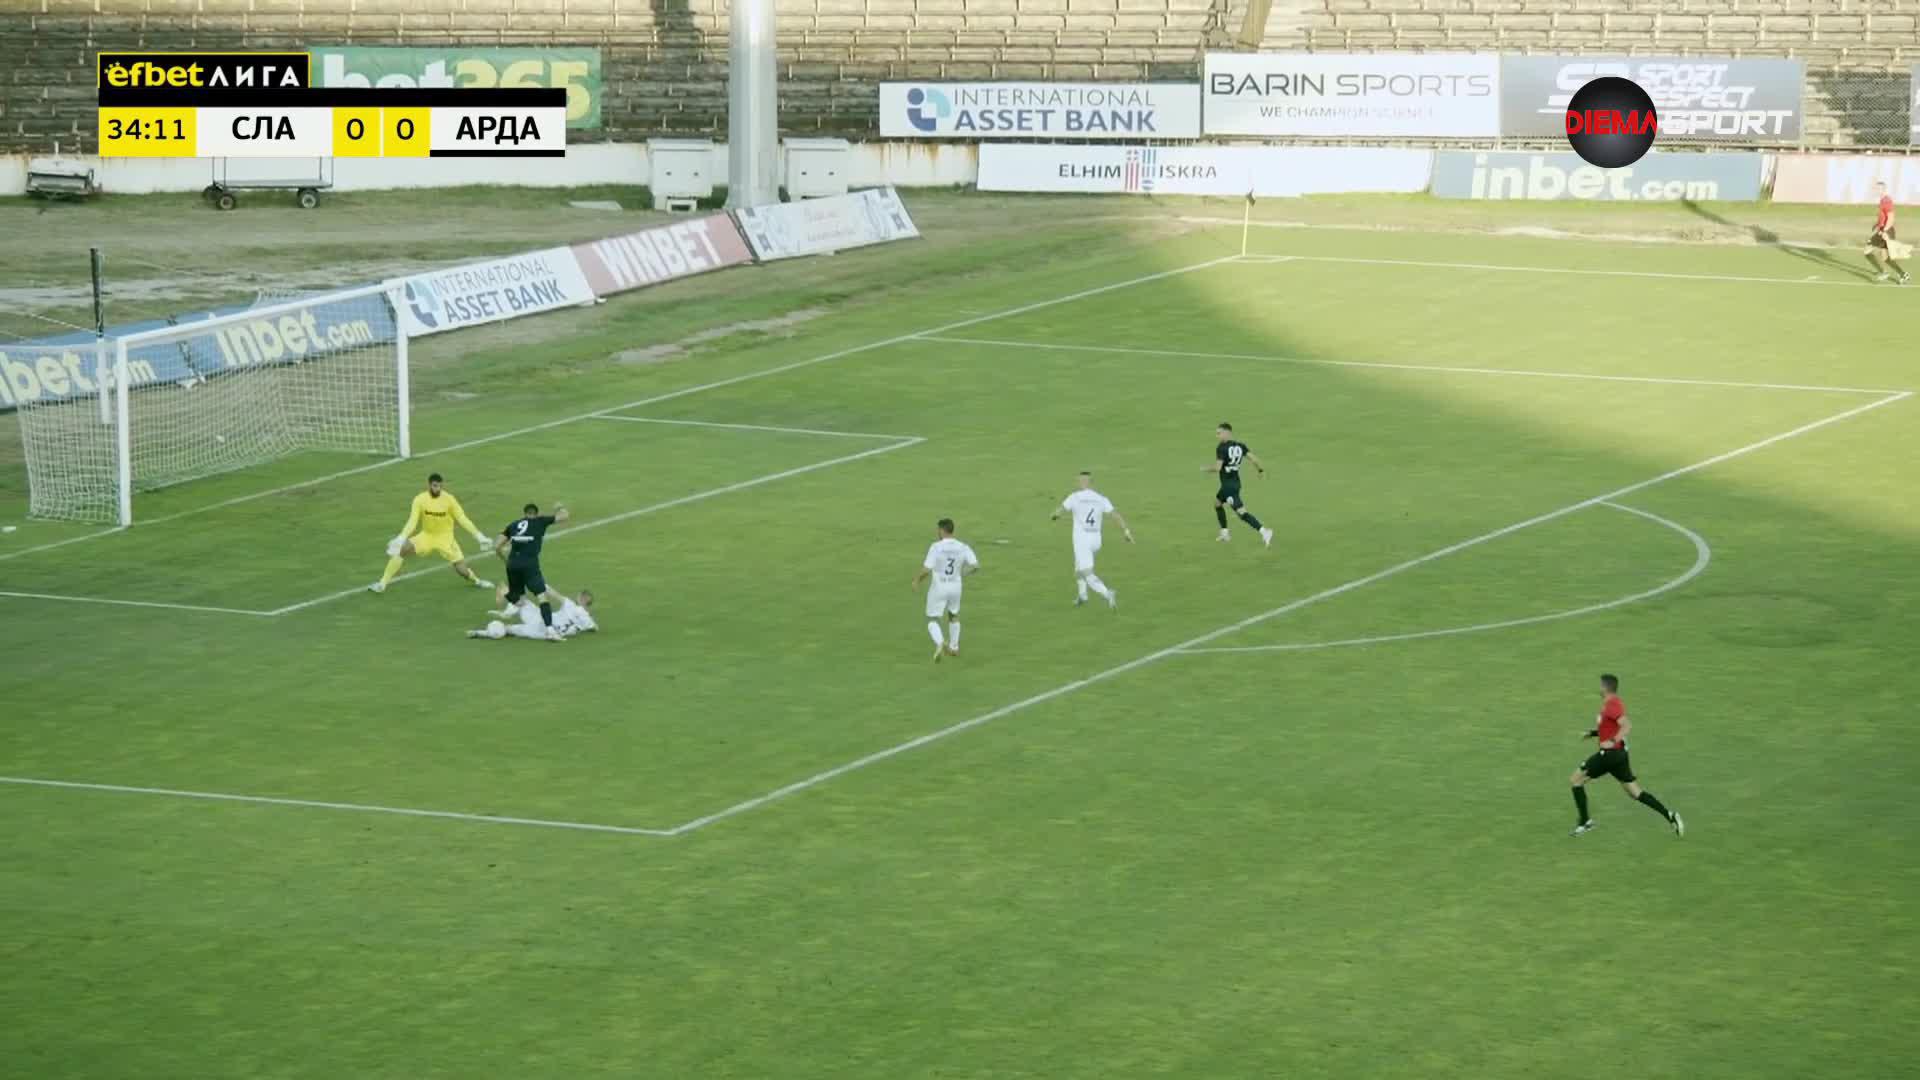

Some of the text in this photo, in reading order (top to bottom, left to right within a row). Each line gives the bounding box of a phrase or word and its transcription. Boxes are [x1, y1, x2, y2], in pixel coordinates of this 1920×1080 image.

[1211, 73, 1491, 97] BARIN SPORTS
[1636, 63, 1728, 87] SPORT
[953, 88, 1156, 106] INTERNATIONAL
[954, 109, 1157, 132] ASSET BANK
[1259, 106, 1282, 118] WE
[1287, 106, 1369, 119] CHAMPION
[1058, 163, 1217, 179] ELHIM ISKRA
[1471, 154, 1718, 201] inbet.com
[592, 218, 722, 288] WINBET
[431, 256, 555, 297] INTERNATIONAL
[442, 279, 568, 323] ASSET BANK
[1227, 446, 1243, 465] 99
[517, 519, 529, 535] 9
[1085, 508, 1096, 527] 4
[944, 558, 955, 576] 3
